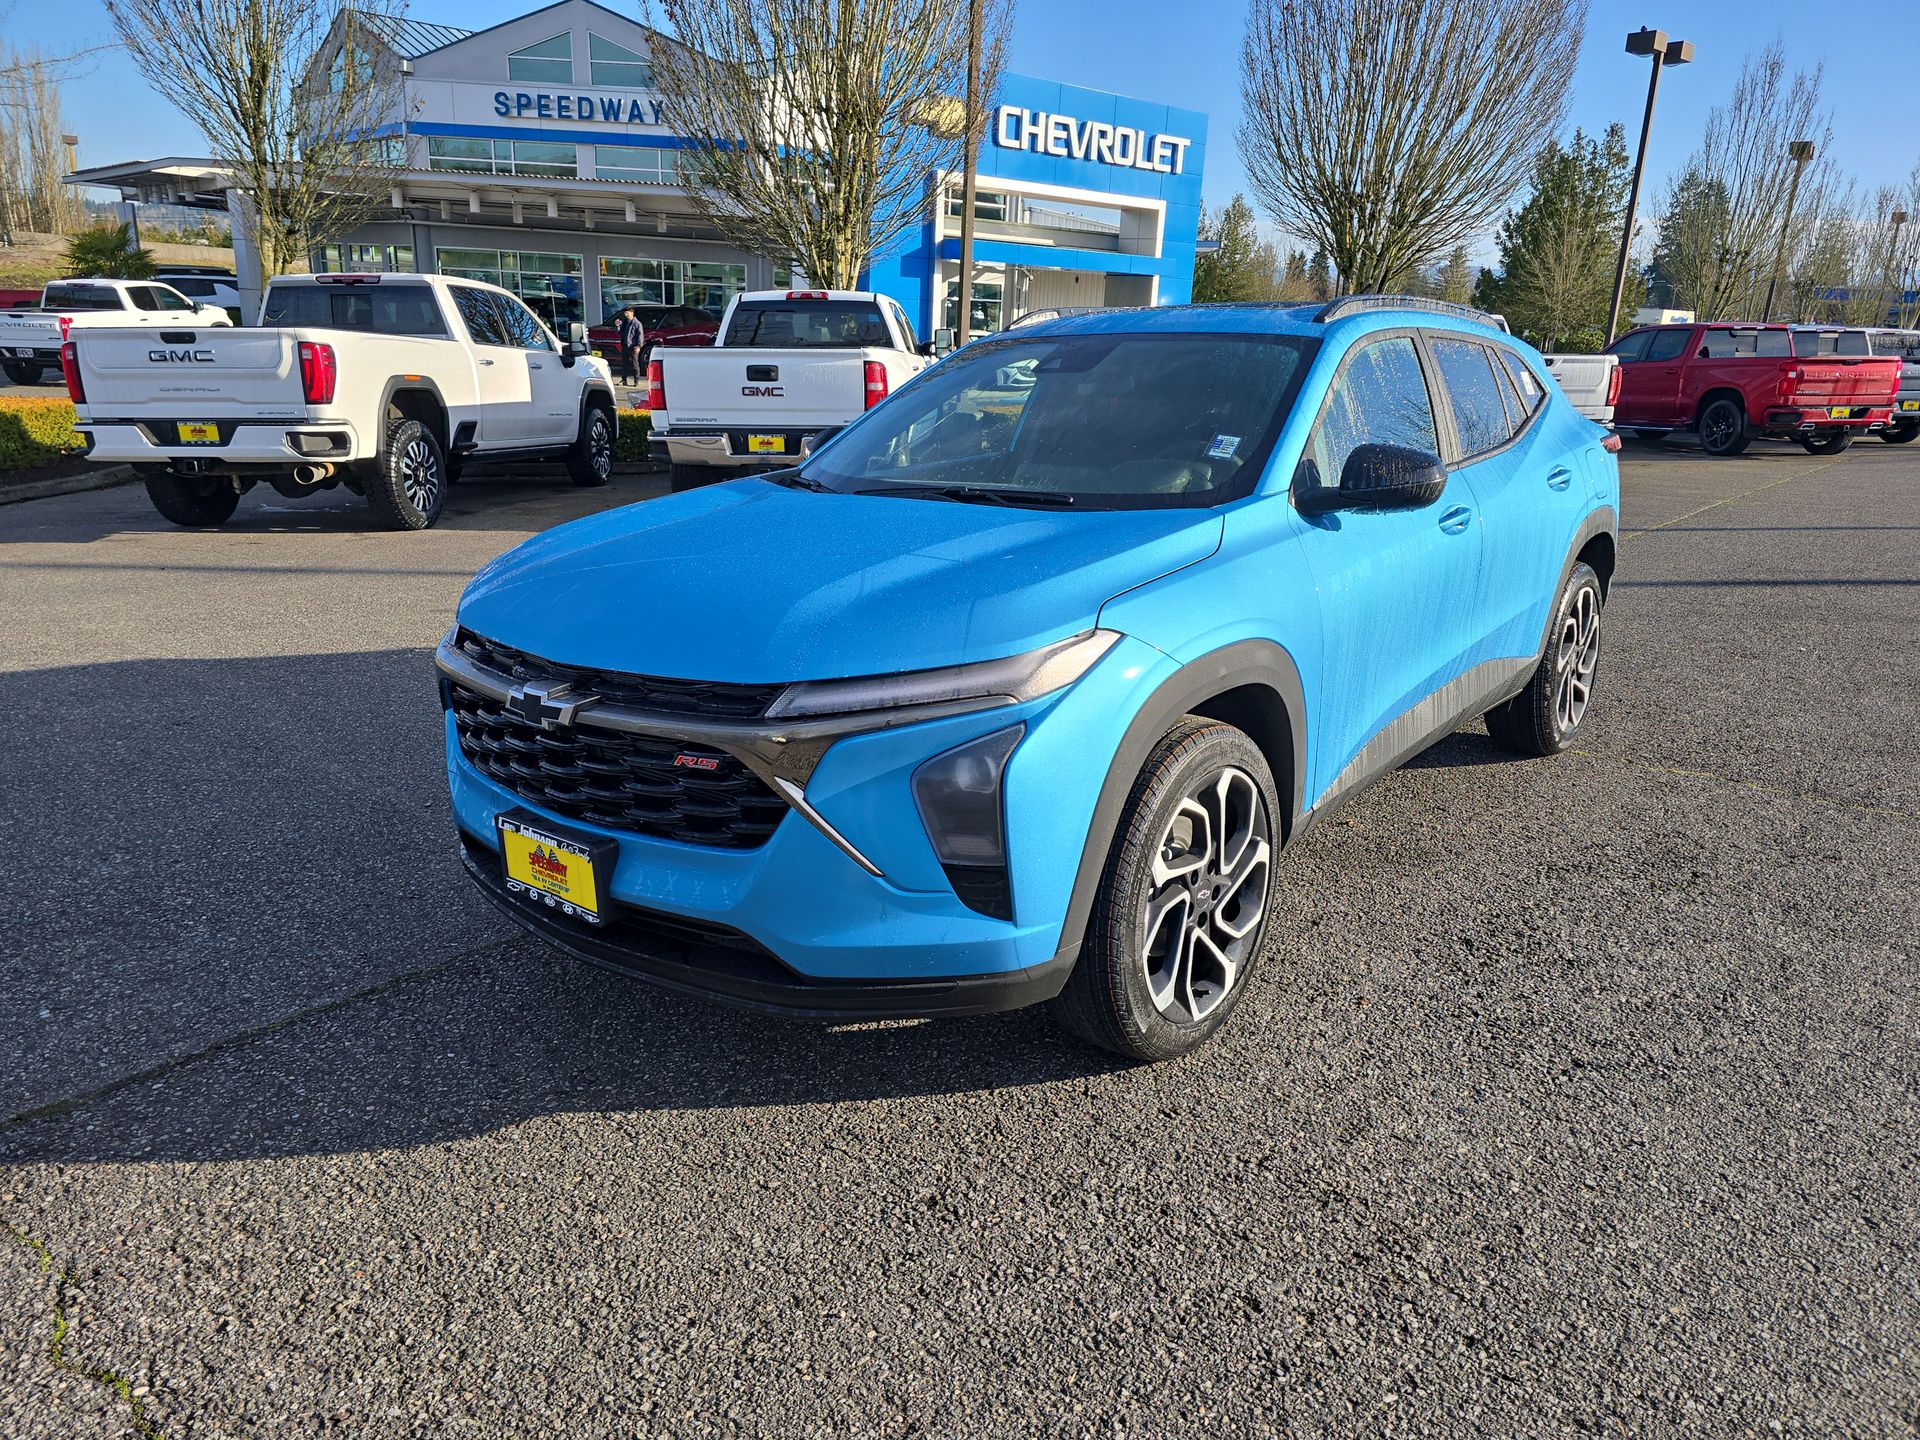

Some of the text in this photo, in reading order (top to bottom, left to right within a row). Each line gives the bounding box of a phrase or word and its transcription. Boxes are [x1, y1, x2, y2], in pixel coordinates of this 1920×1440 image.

[494, 91, 664, 125] SPEEDWAY
[998, 104, 1191, 174] CHEVROLET
[149, 350, 215, 362] GMC
[742, 386, 785, 397] GMC
[674, 754, 719, 771] RS
[518, 823, 559, 849] Johnson
[531, 866, 568, 886] CHEVROLET
